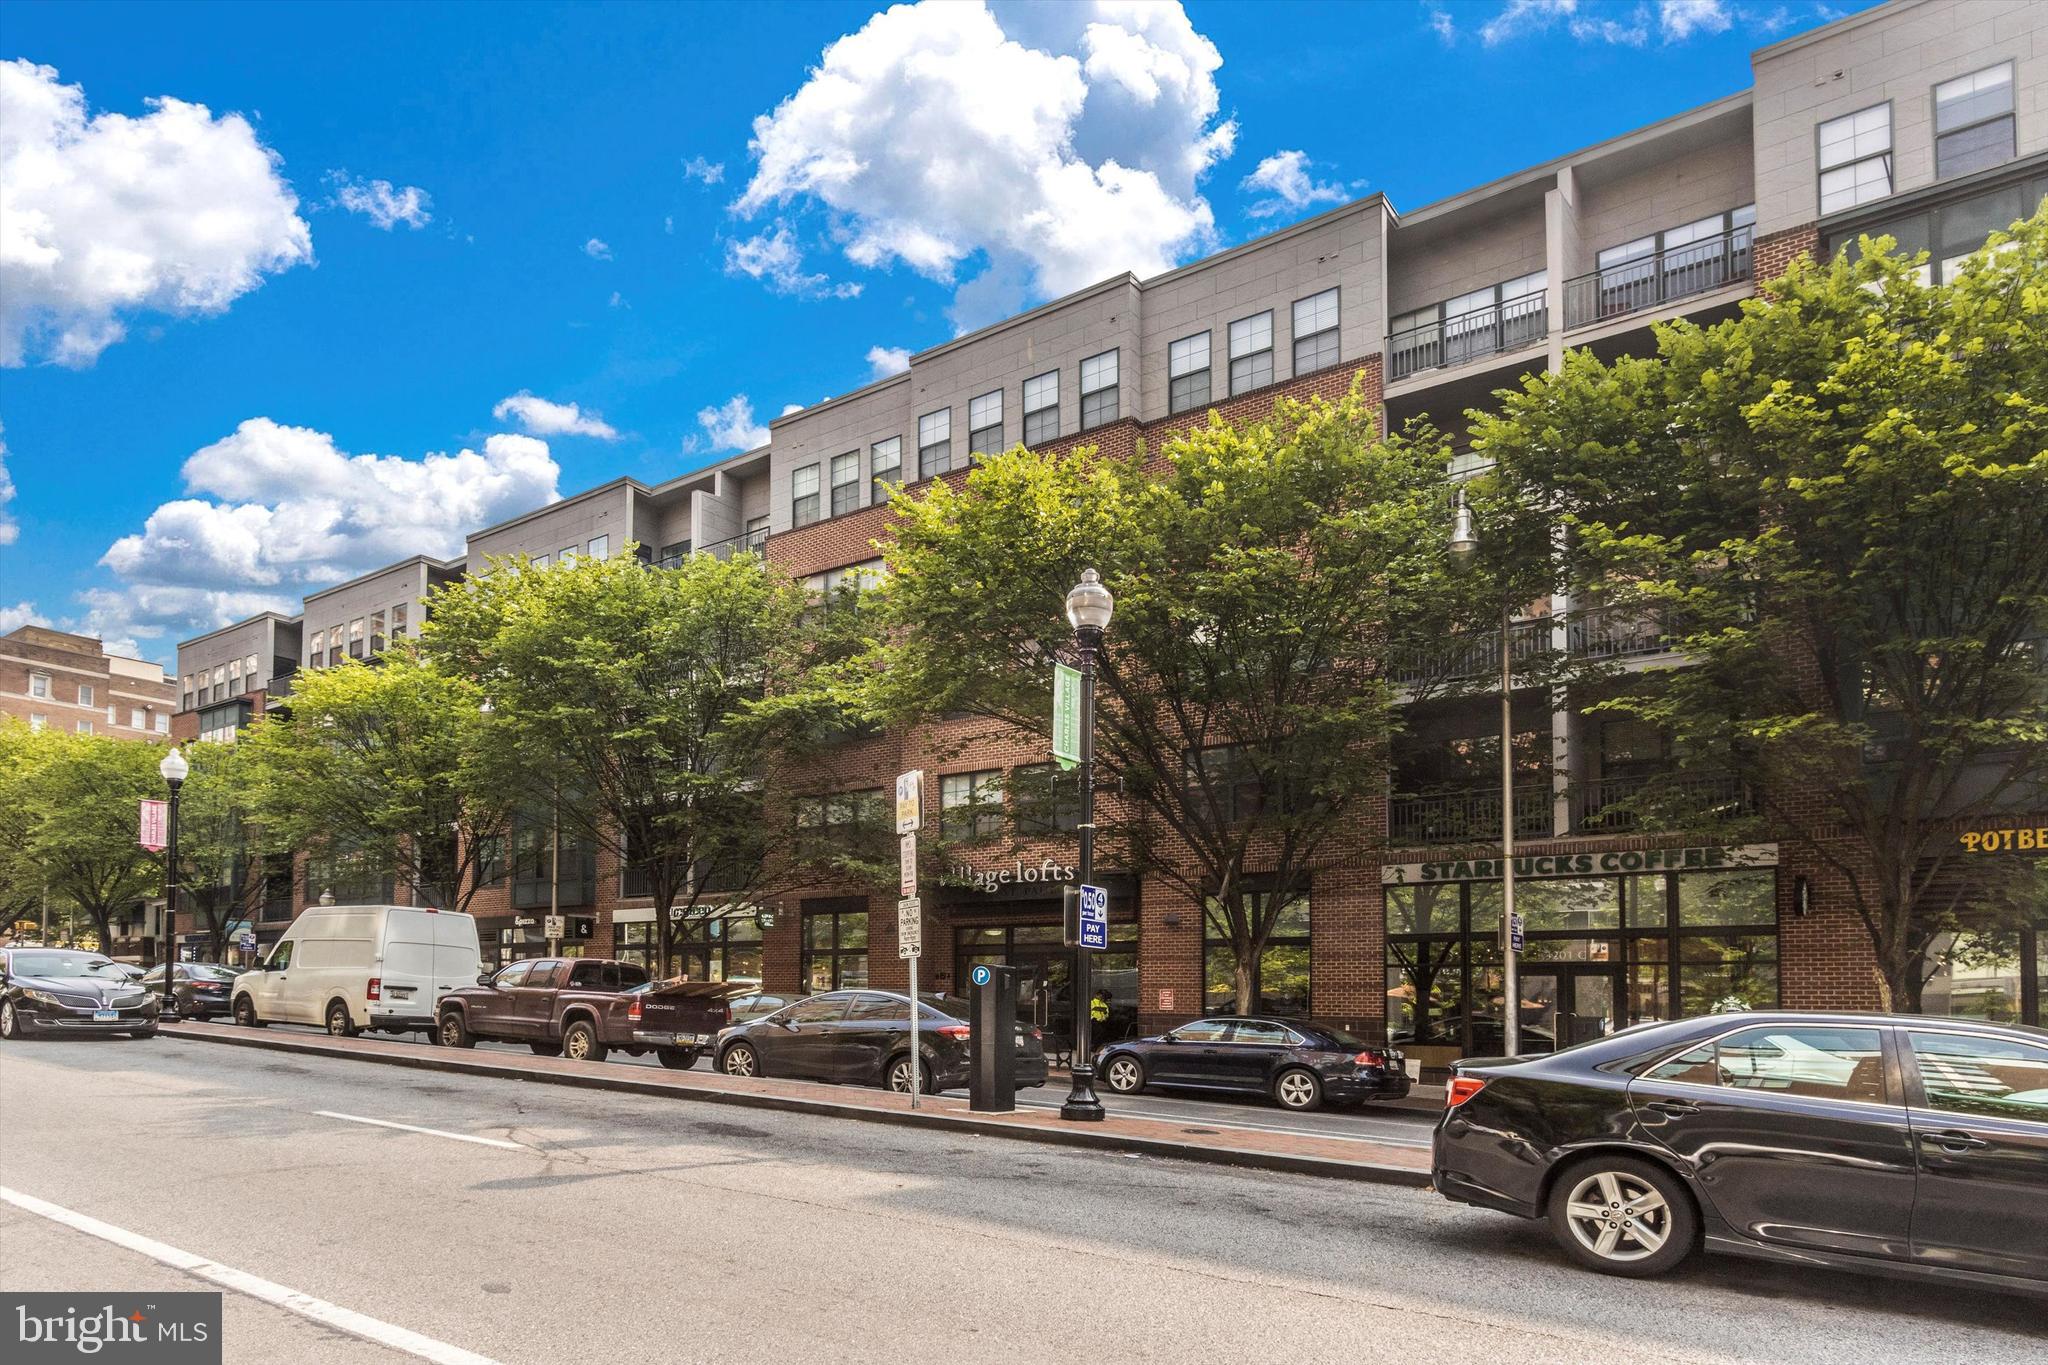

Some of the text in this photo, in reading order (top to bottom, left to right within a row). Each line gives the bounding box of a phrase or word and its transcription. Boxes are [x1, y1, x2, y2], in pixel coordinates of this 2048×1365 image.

[1063, 675, 1071, 753] CHARLES VILLAGE
[1960, 827, 2048, 852] POTBE
[1015, 859, 1075, 883] lofts
[1600, 847, 1725, 871] COFFEE
[1083, 934, 1103, 944] HERE
[1086, 924, 1101, 933] PAY
[978, 969, 985, 982] P
